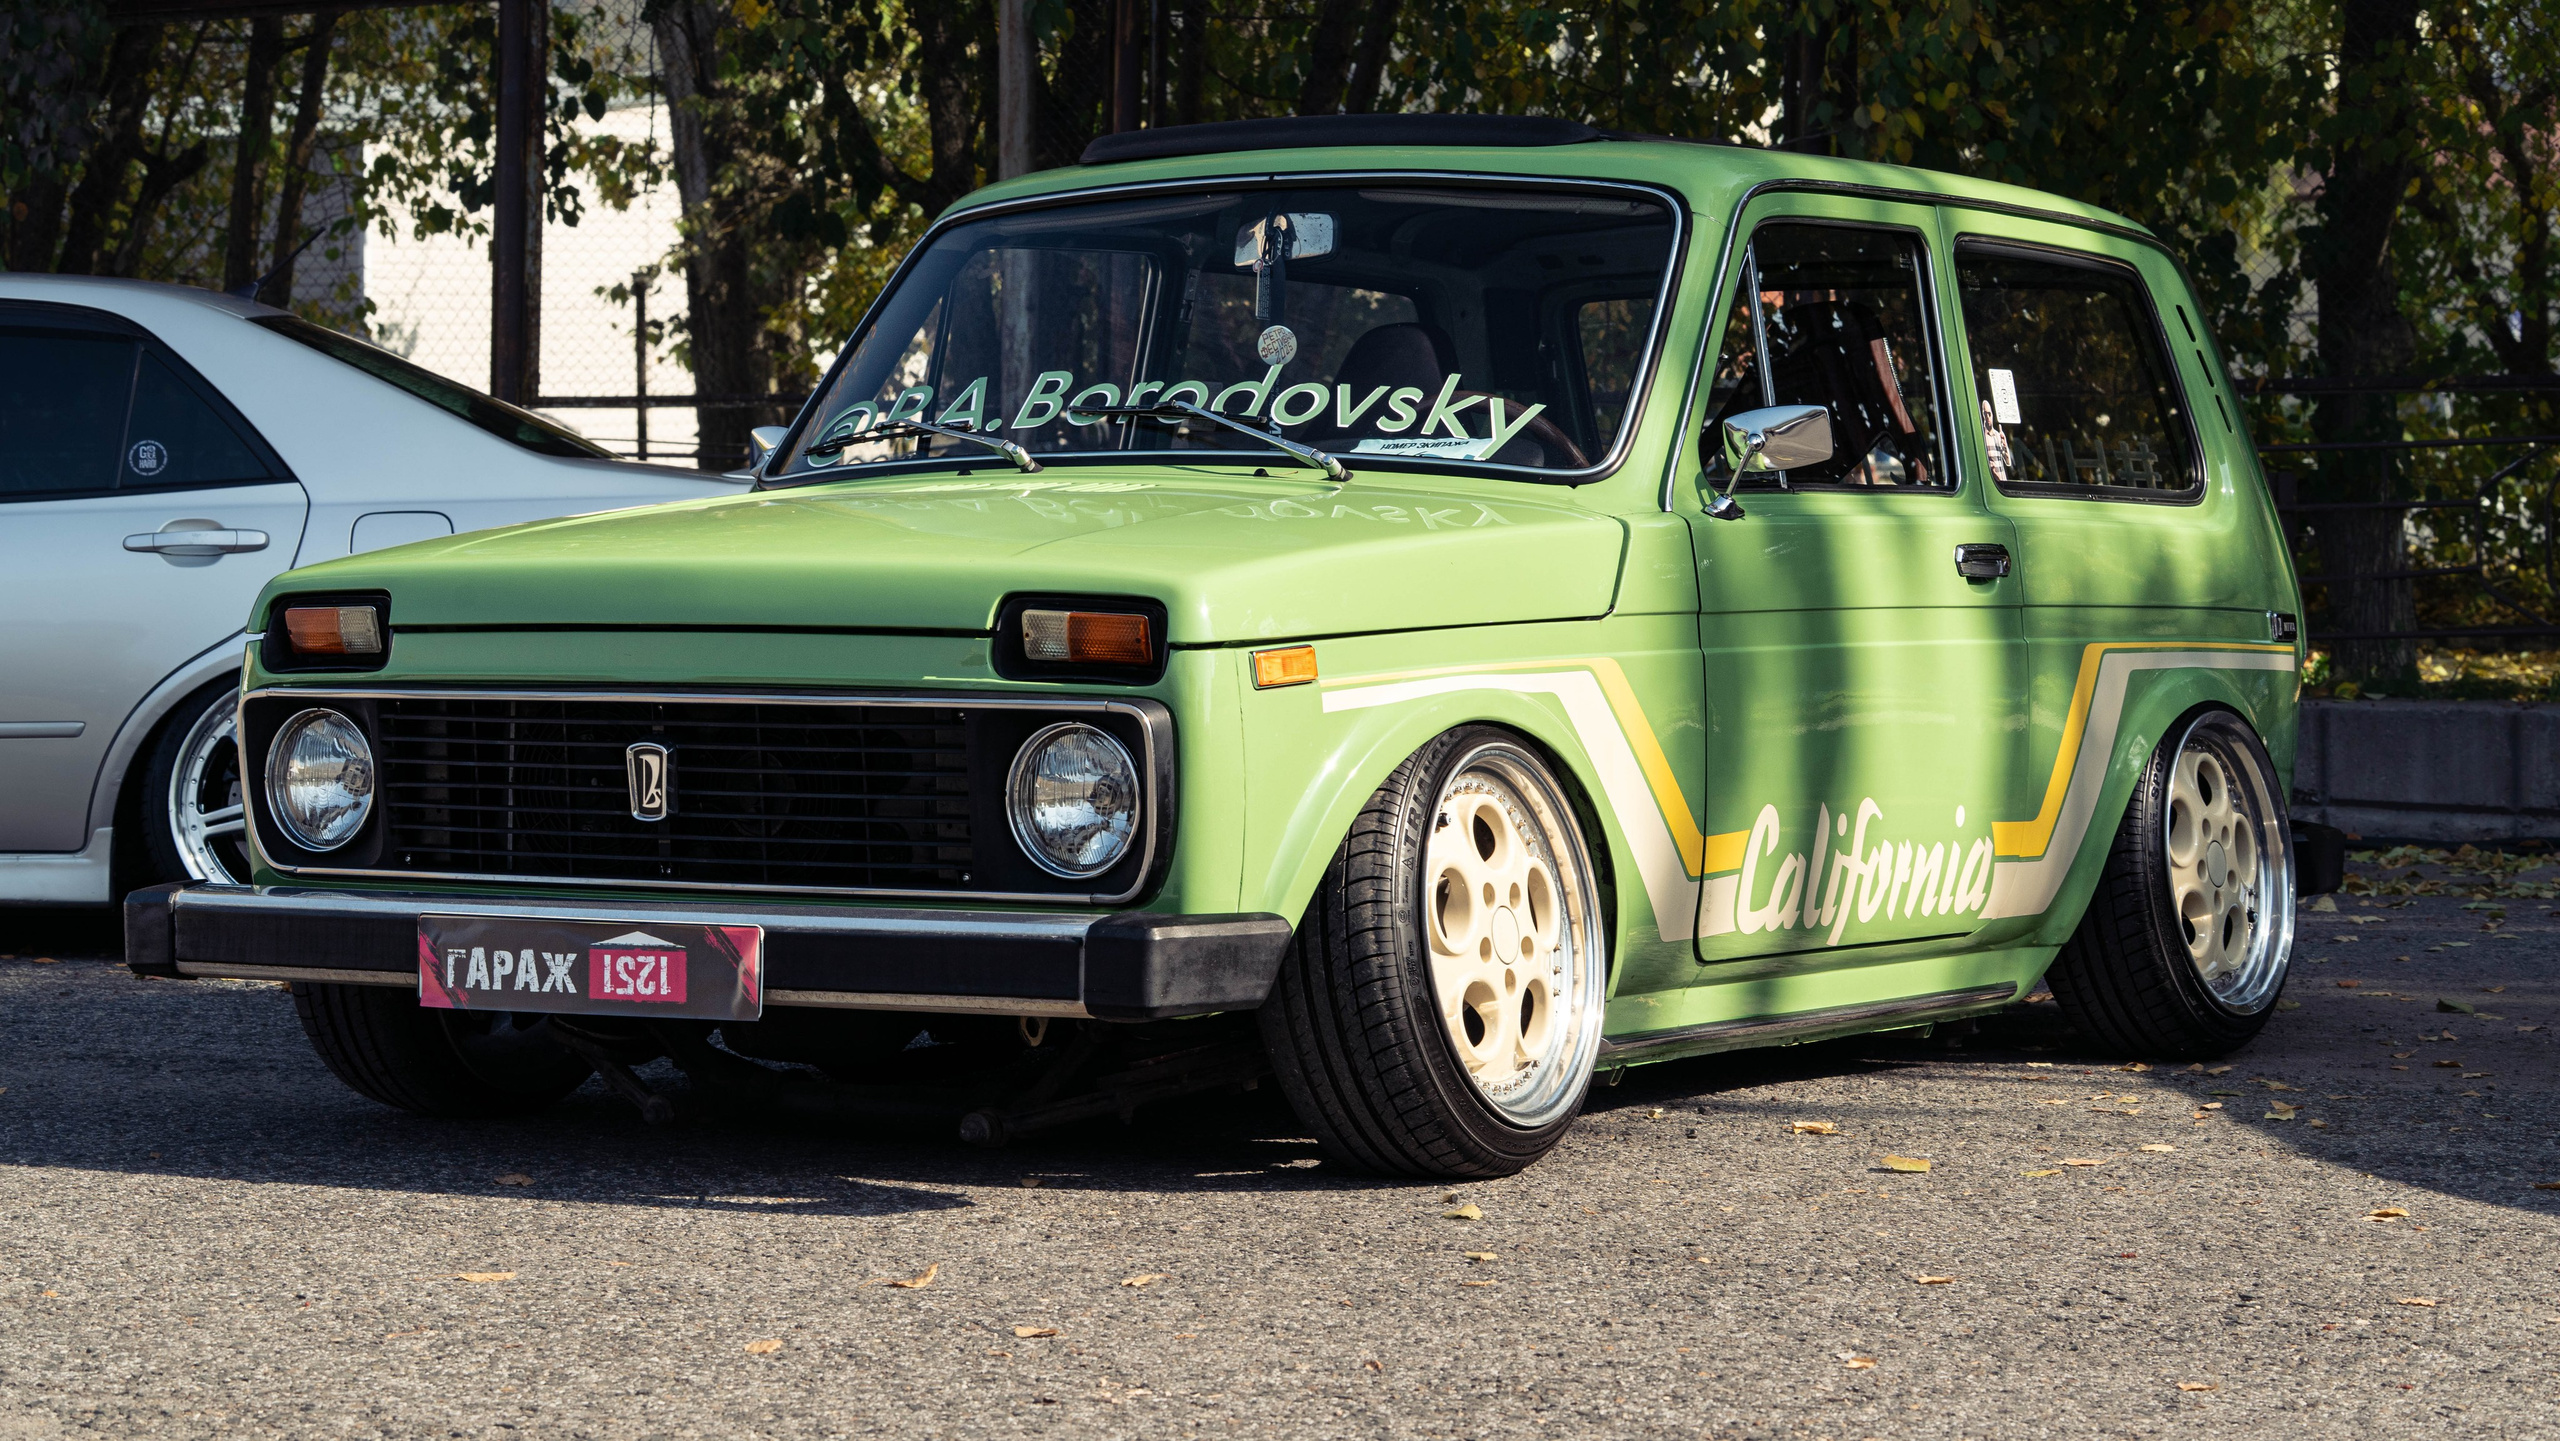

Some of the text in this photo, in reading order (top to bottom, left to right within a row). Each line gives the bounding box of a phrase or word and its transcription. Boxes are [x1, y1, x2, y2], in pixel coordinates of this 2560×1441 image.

[1380, 442, 1417, 451] НОМЕР
[1402, 726, 1462, 851] TRIANGLE
[1736, 796, 1994, 946] California
[447, 946, 578, 994] ГАРАЖ
